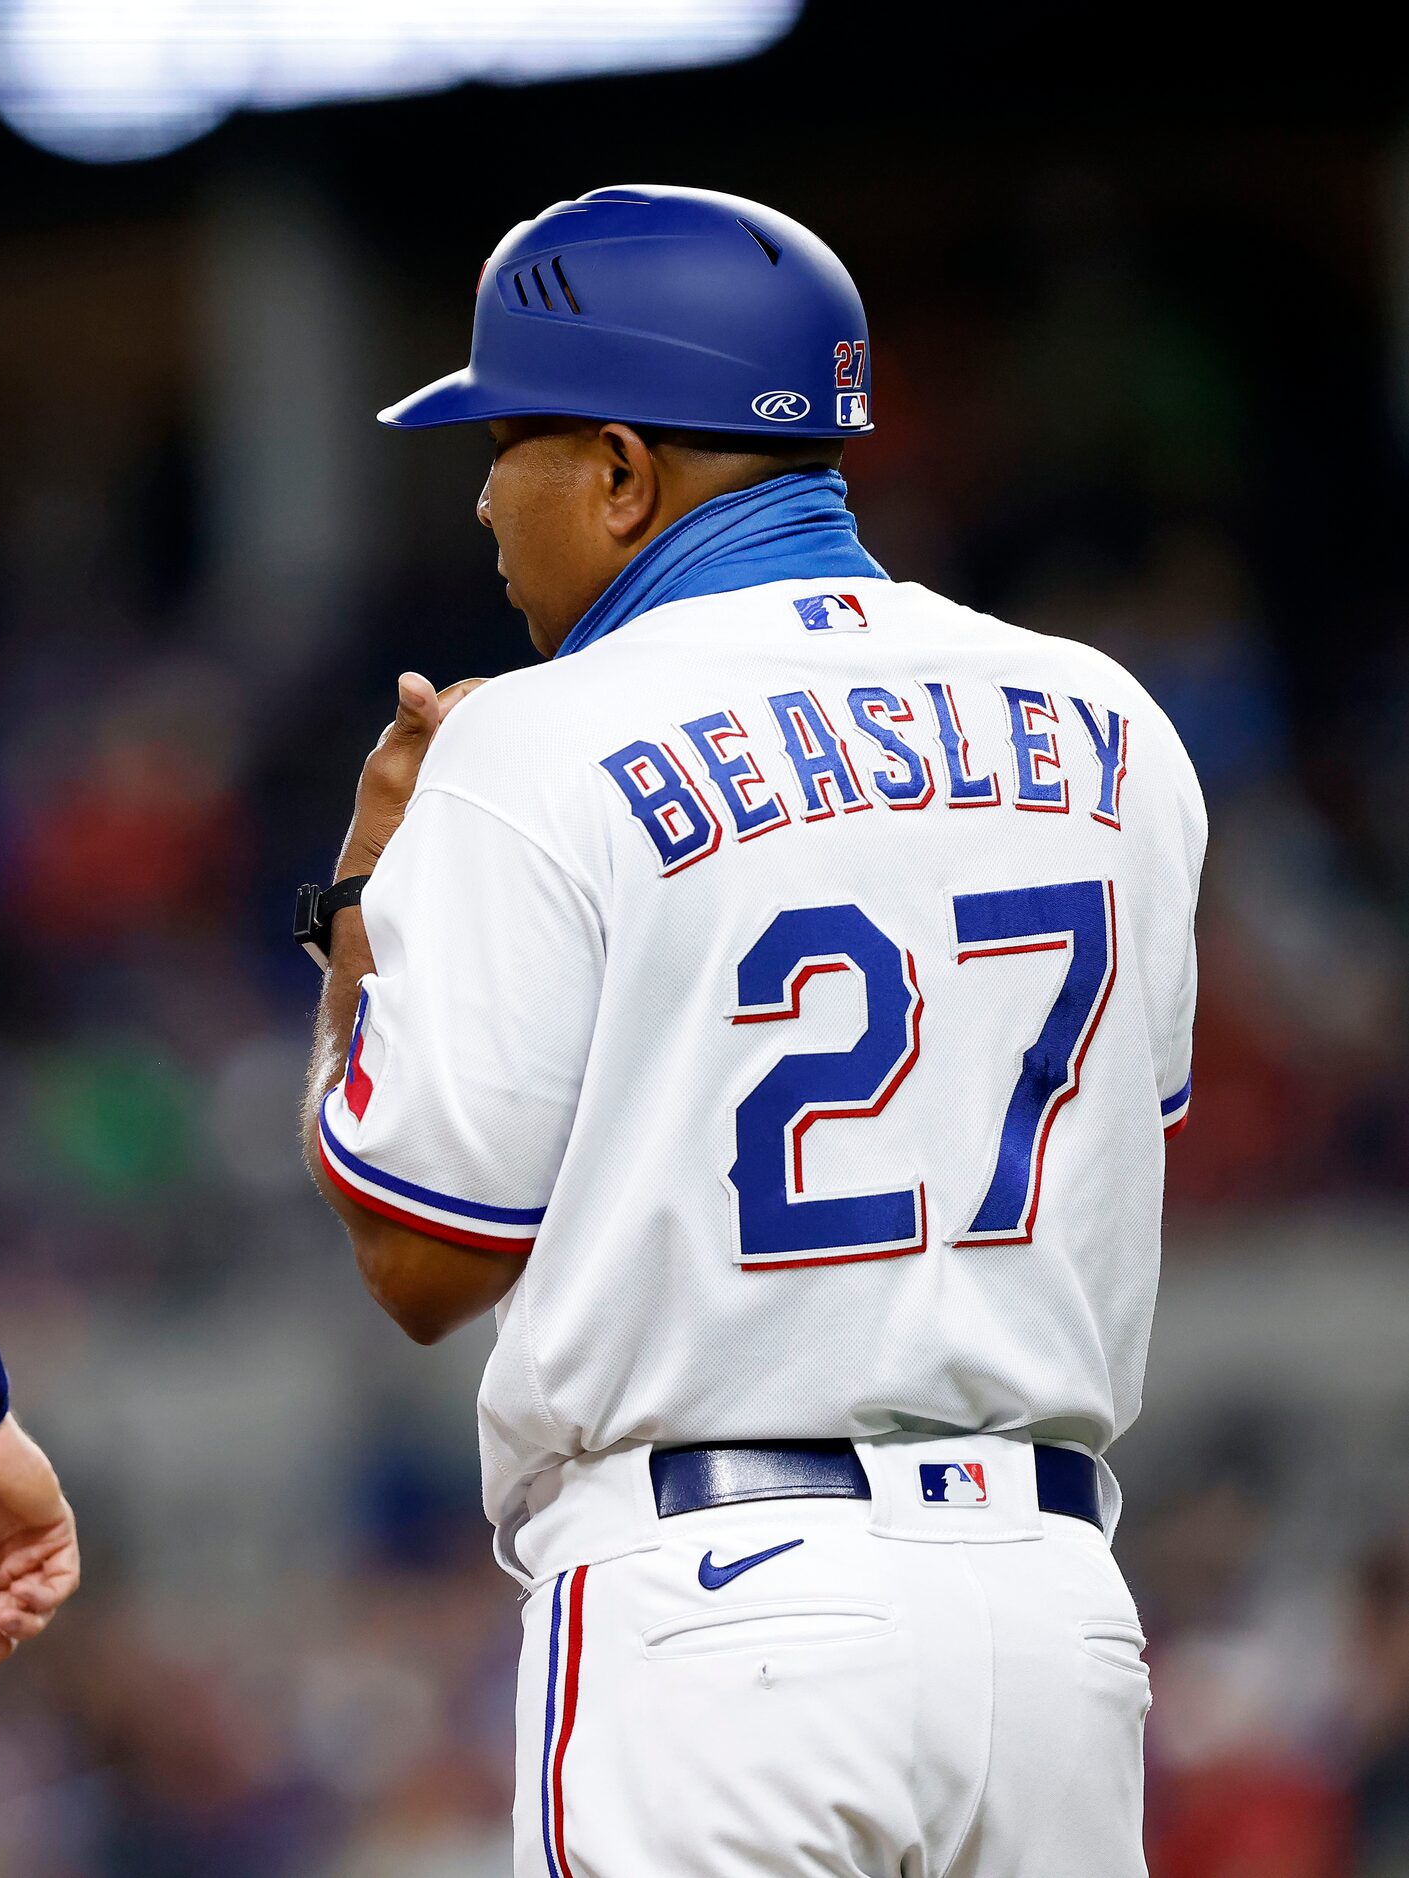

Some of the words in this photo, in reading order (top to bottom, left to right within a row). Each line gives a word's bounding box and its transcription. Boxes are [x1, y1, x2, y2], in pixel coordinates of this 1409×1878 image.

[834, 341, 865, 389] 27
[594, 681, 1129, 878] BEASLEY
[719, 875, 1117, 1271] 27
